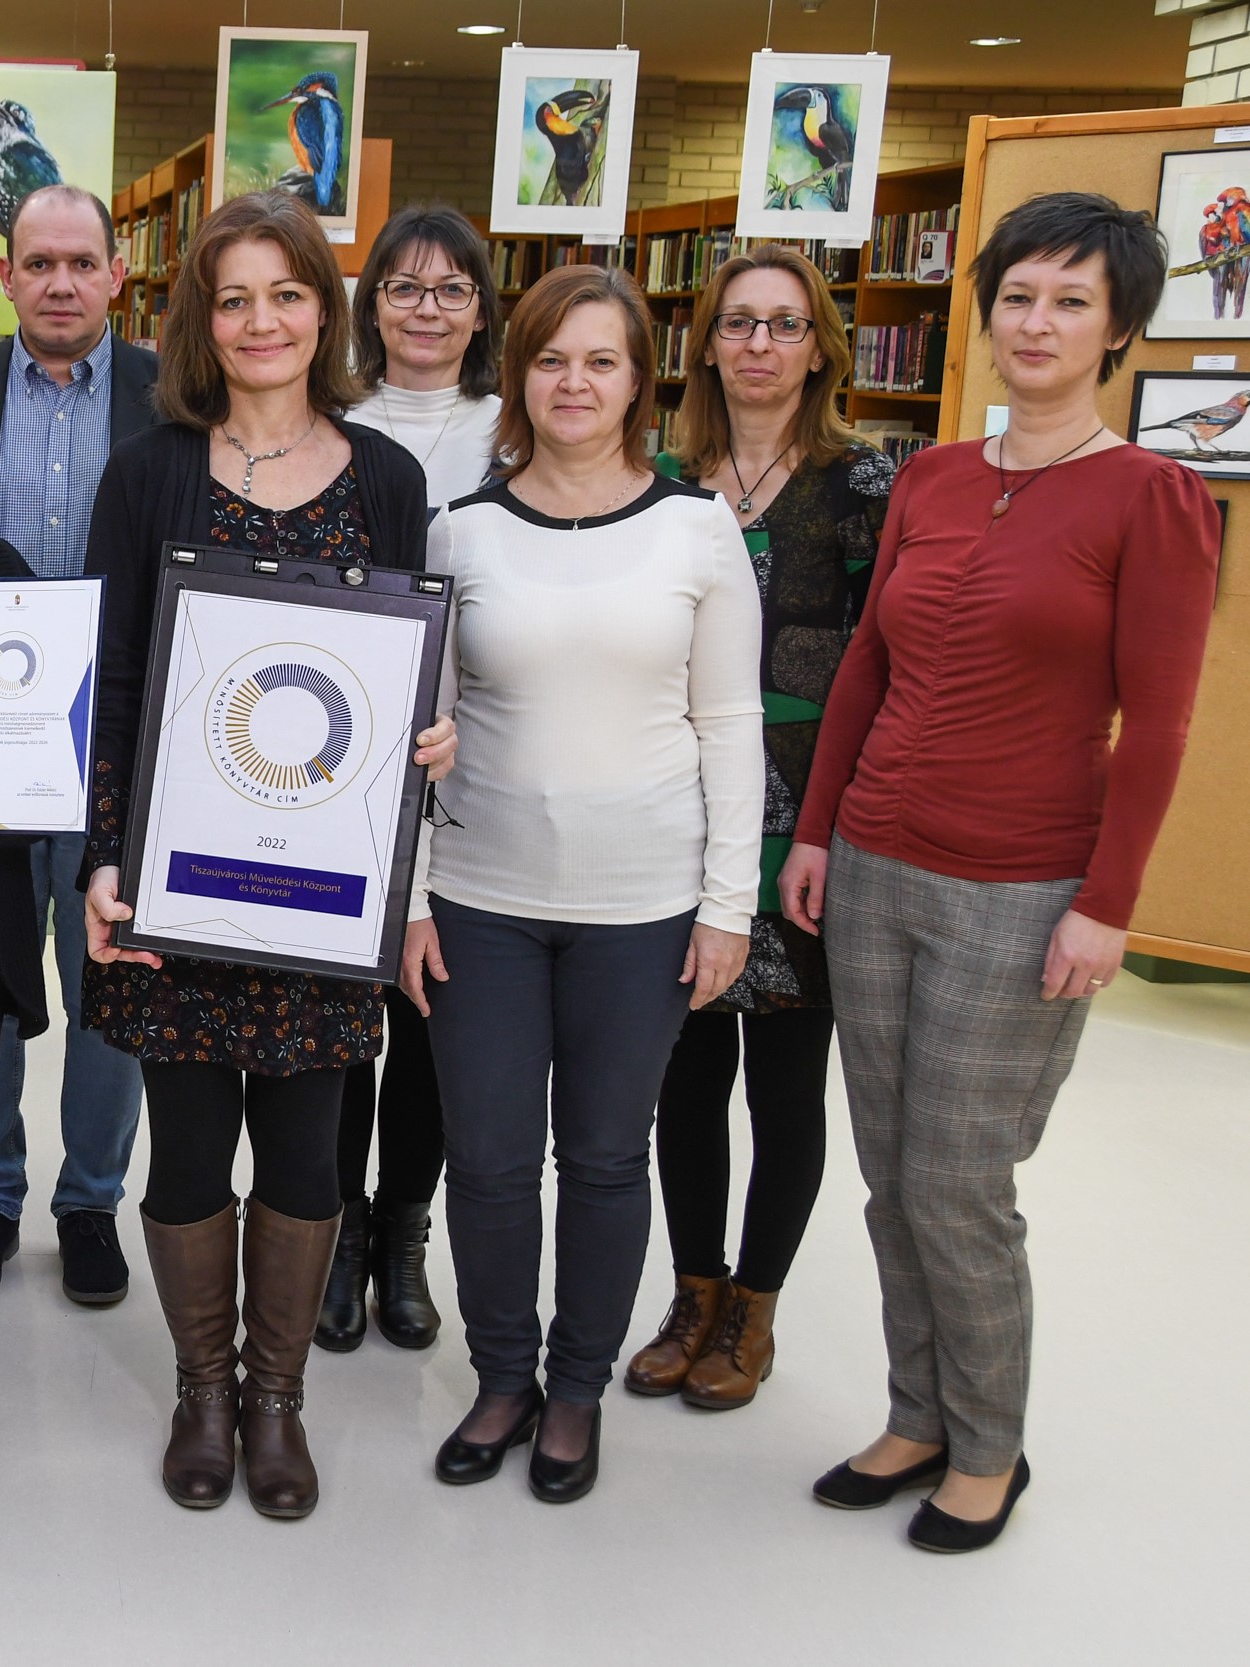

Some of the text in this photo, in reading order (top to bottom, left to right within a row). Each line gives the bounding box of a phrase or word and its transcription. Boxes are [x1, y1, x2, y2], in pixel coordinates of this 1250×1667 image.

[277, 795, 298, 803] CÍM
[256, 835, 287, 850] 2022
[190, 864, 342, 894] Tiszaújvárosi Művelődési Központ
[238, 882, 292, 898] és Könyvtár
